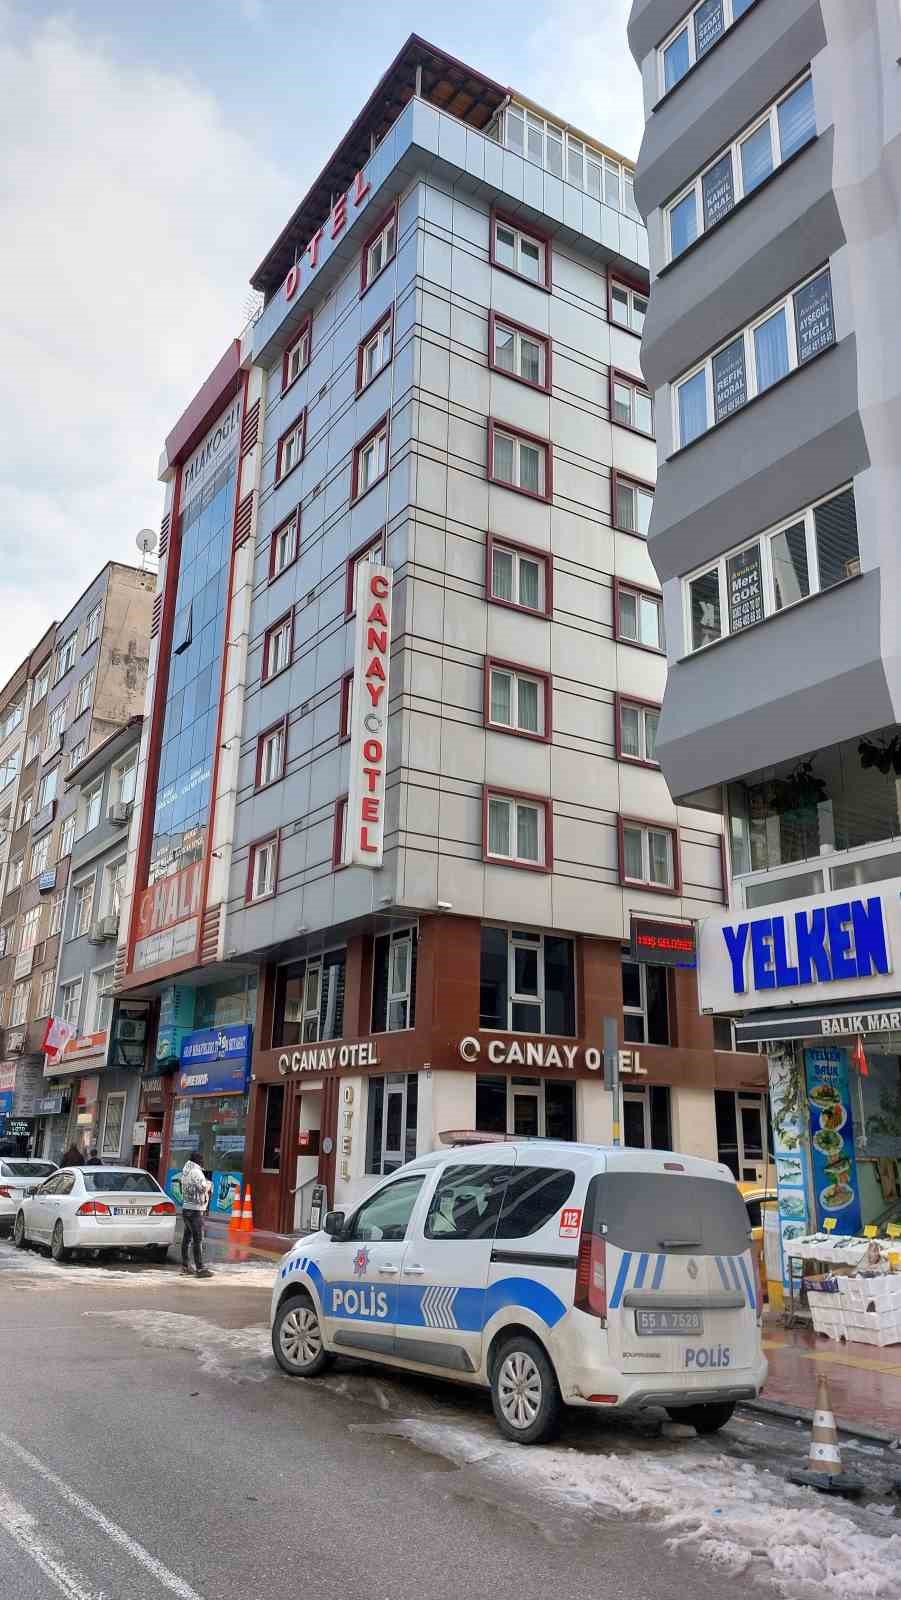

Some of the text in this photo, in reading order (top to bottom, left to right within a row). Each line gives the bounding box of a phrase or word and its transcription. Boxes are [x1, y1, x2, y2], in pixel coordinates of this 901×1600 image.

[283, 171, 370, 301] OTEL
[732, 570, 758, 592] Mert
[360, 575, 389, 853] CANAY OTEL
[722, 897, 890, 993] YELKEN
[821, 1015, 864, 1034] BALIK
[291, 1042, 377, 1073] CANAY OTEL
[488, 1040, 579, 1070] CANAY
[585, 1047, 648, 1075] OEL
[340, 1087, 353, 1183] OTEL
[564, 1211, 578, 1226] 112
[332, 1285, 388, 1318] POLİS
[661, 1314, 668, 1328] A
[685, 1344, 730, 1368] POLİS
